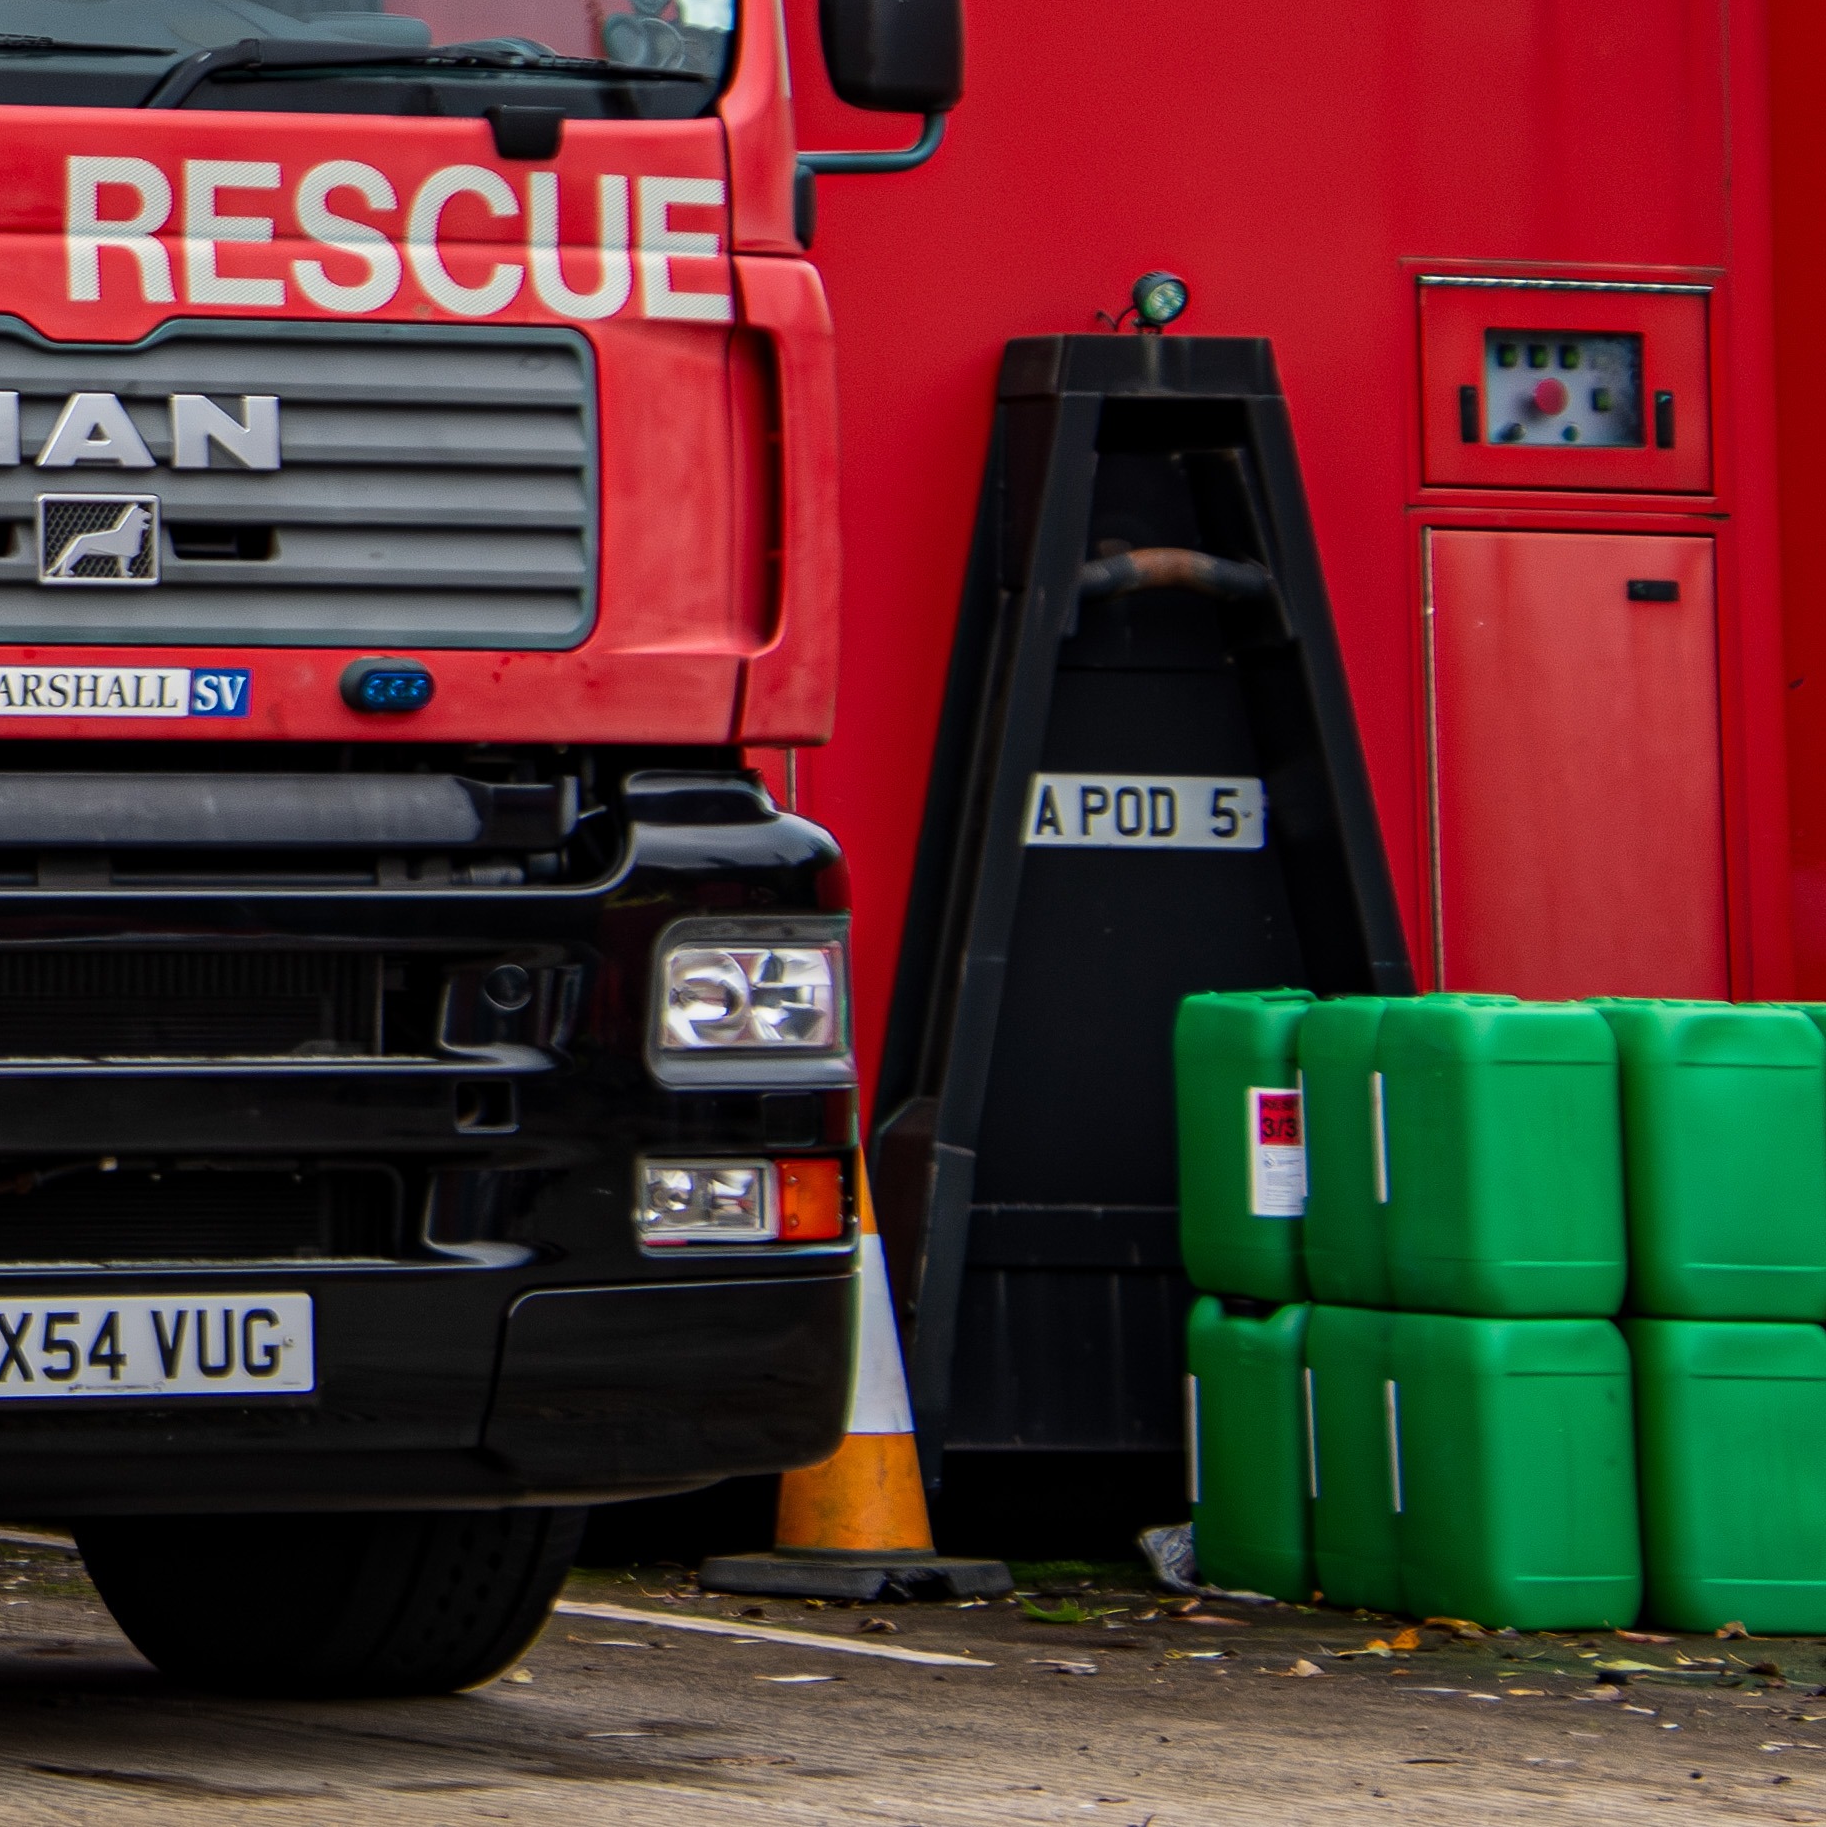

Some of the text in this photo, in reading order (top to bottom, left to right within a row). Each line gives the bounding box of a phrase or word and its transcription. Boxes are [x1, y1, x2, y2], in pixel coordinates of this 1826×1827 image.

[66, 154, 734, 323] RESCUE
[194, 674, 247, 711] SV
[1033, 783, 1241, 839] A POD 5
[150, 1307, 282, 1379] VUG
